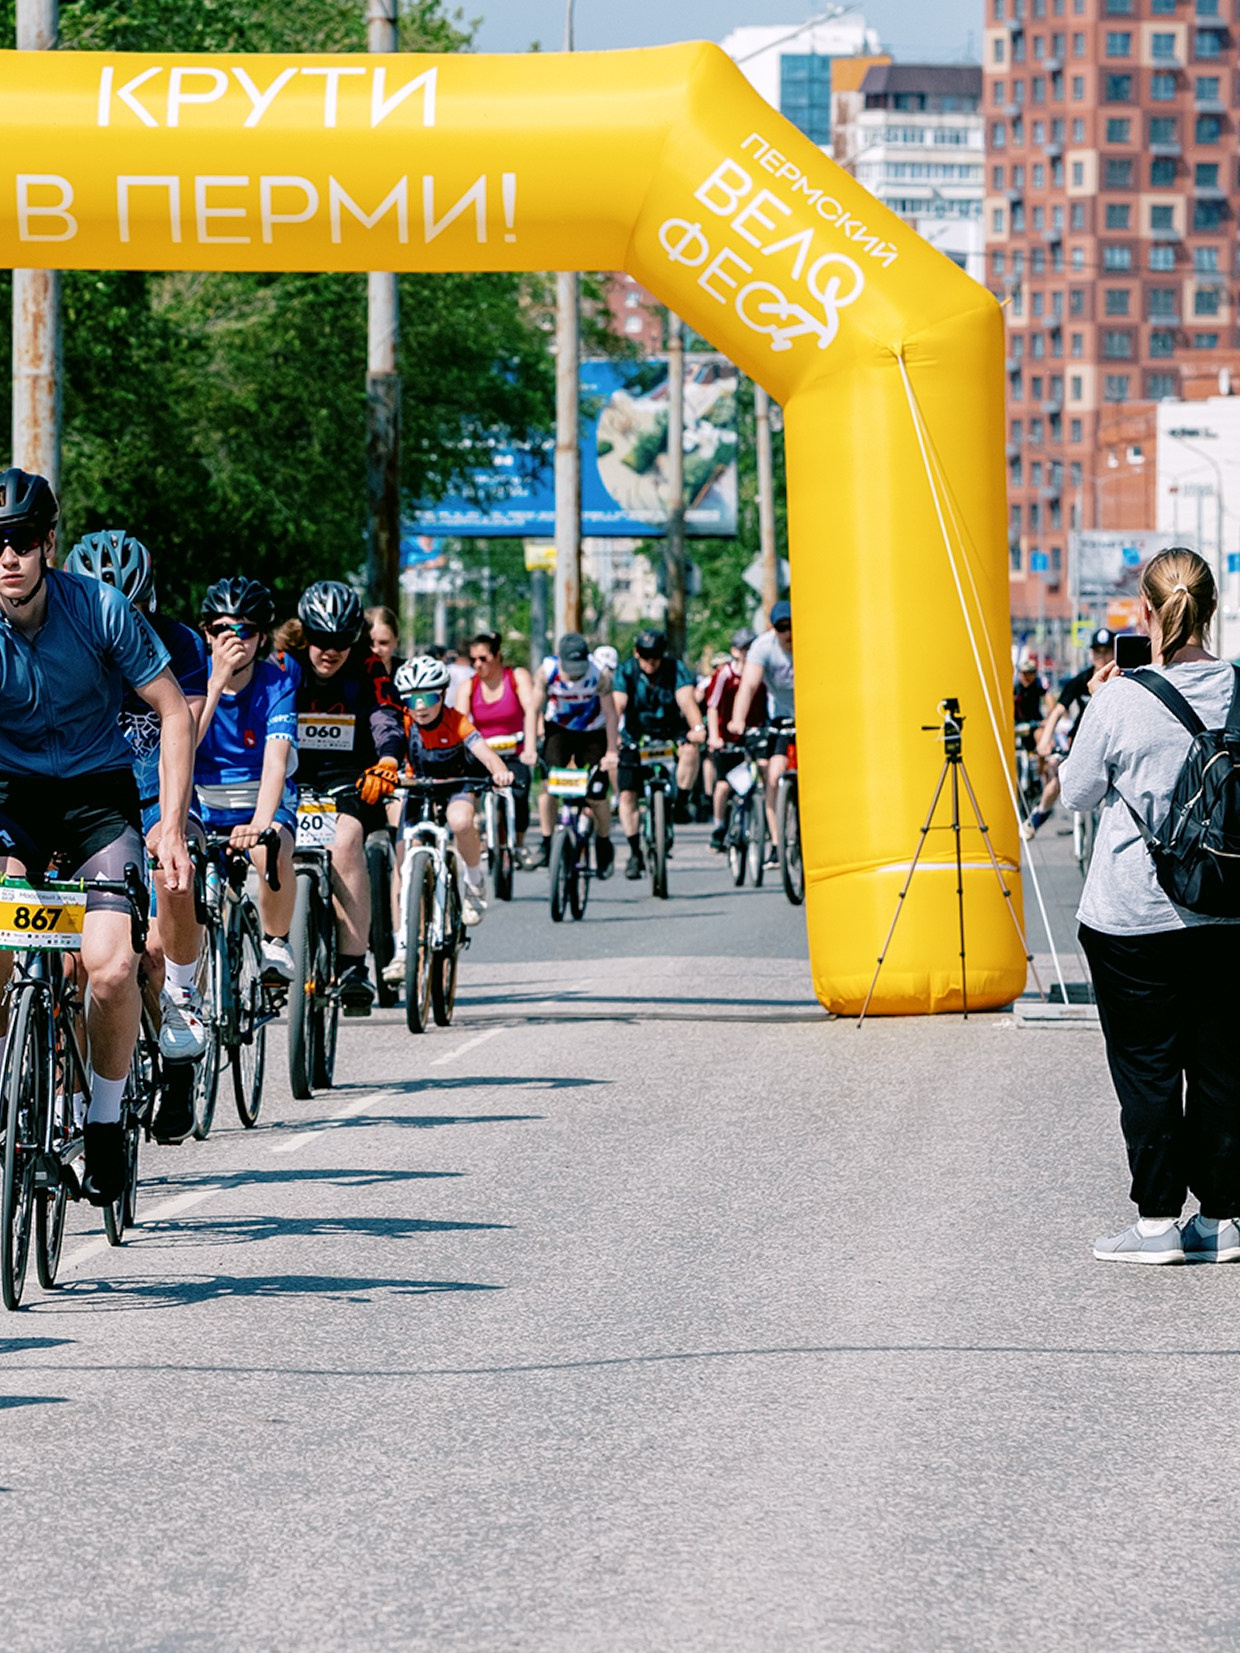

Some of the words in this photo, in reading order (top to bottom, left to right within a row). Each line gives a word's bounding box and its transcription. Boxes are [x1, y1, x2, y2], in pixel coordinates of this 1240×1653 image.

[97, 66, 439, 128] КРУТИ
[16, 173, 79, 243] В
[116, 172, 517, 244] ПЕРМИ!
[694, 157, 865, 308] ВЕЛО
[740, 132, 899, 268] ПЕРМСКИЙ
[305, 726, 341, 738] 060
[13, 906, 63, 931] 867
